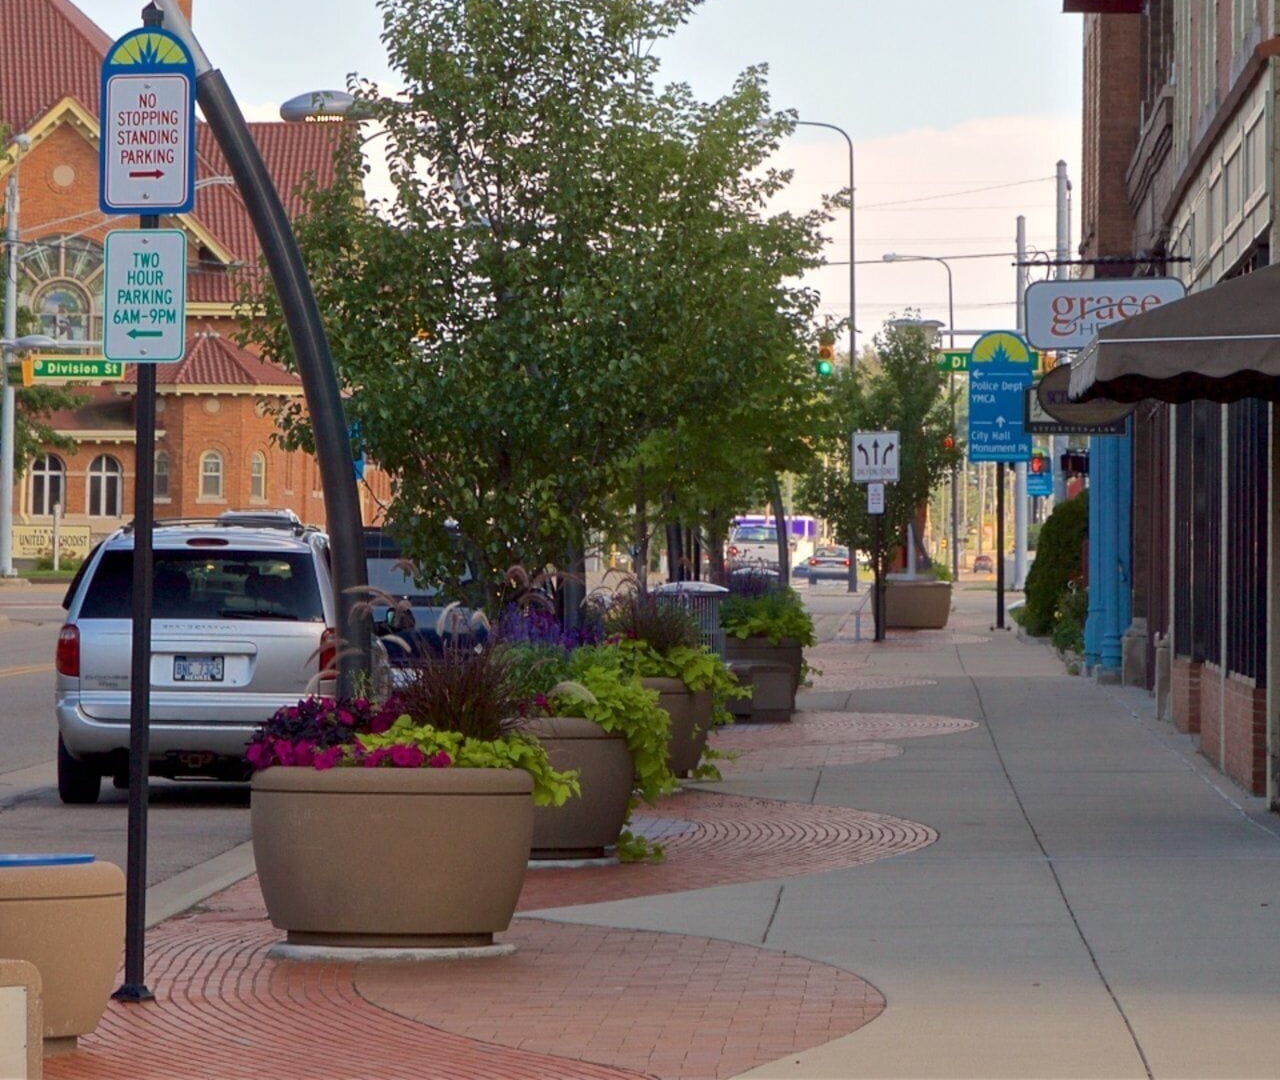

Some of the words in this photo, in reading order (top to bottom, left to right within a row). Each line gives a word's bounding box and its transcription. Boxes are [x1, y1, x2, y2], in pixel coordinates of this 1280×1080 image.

[139, 93, 157, 109] NO
[117, 110, 179, 127] STOPPING
[117, 129, 179, 146] STANDING
[120, 148, 175, 165] PARKING
[133, 252, 160, 269] TWO
[127, 270, 164, 286] HOUR
[117, 289, 173, 305] PARKING
[113, 308, 177, 325] 6AM-9PM
[1050, 294, 1162, 336] grace
[47, 362, 99, 374] Division
[104, 362, 118, 374] St
[971, 381, 999, 391] Police
[1001, 381, 1023, 393] Dept
[971, 394, 996, 403] YMCA
[971, 431, 989, 442] City
[991, 431, 1011, 440] Hall
[971, 443, 1016, 453] Monument
[1017, 443, 1029, 453] Pk
[19, 535, 45, 546] UNITED
